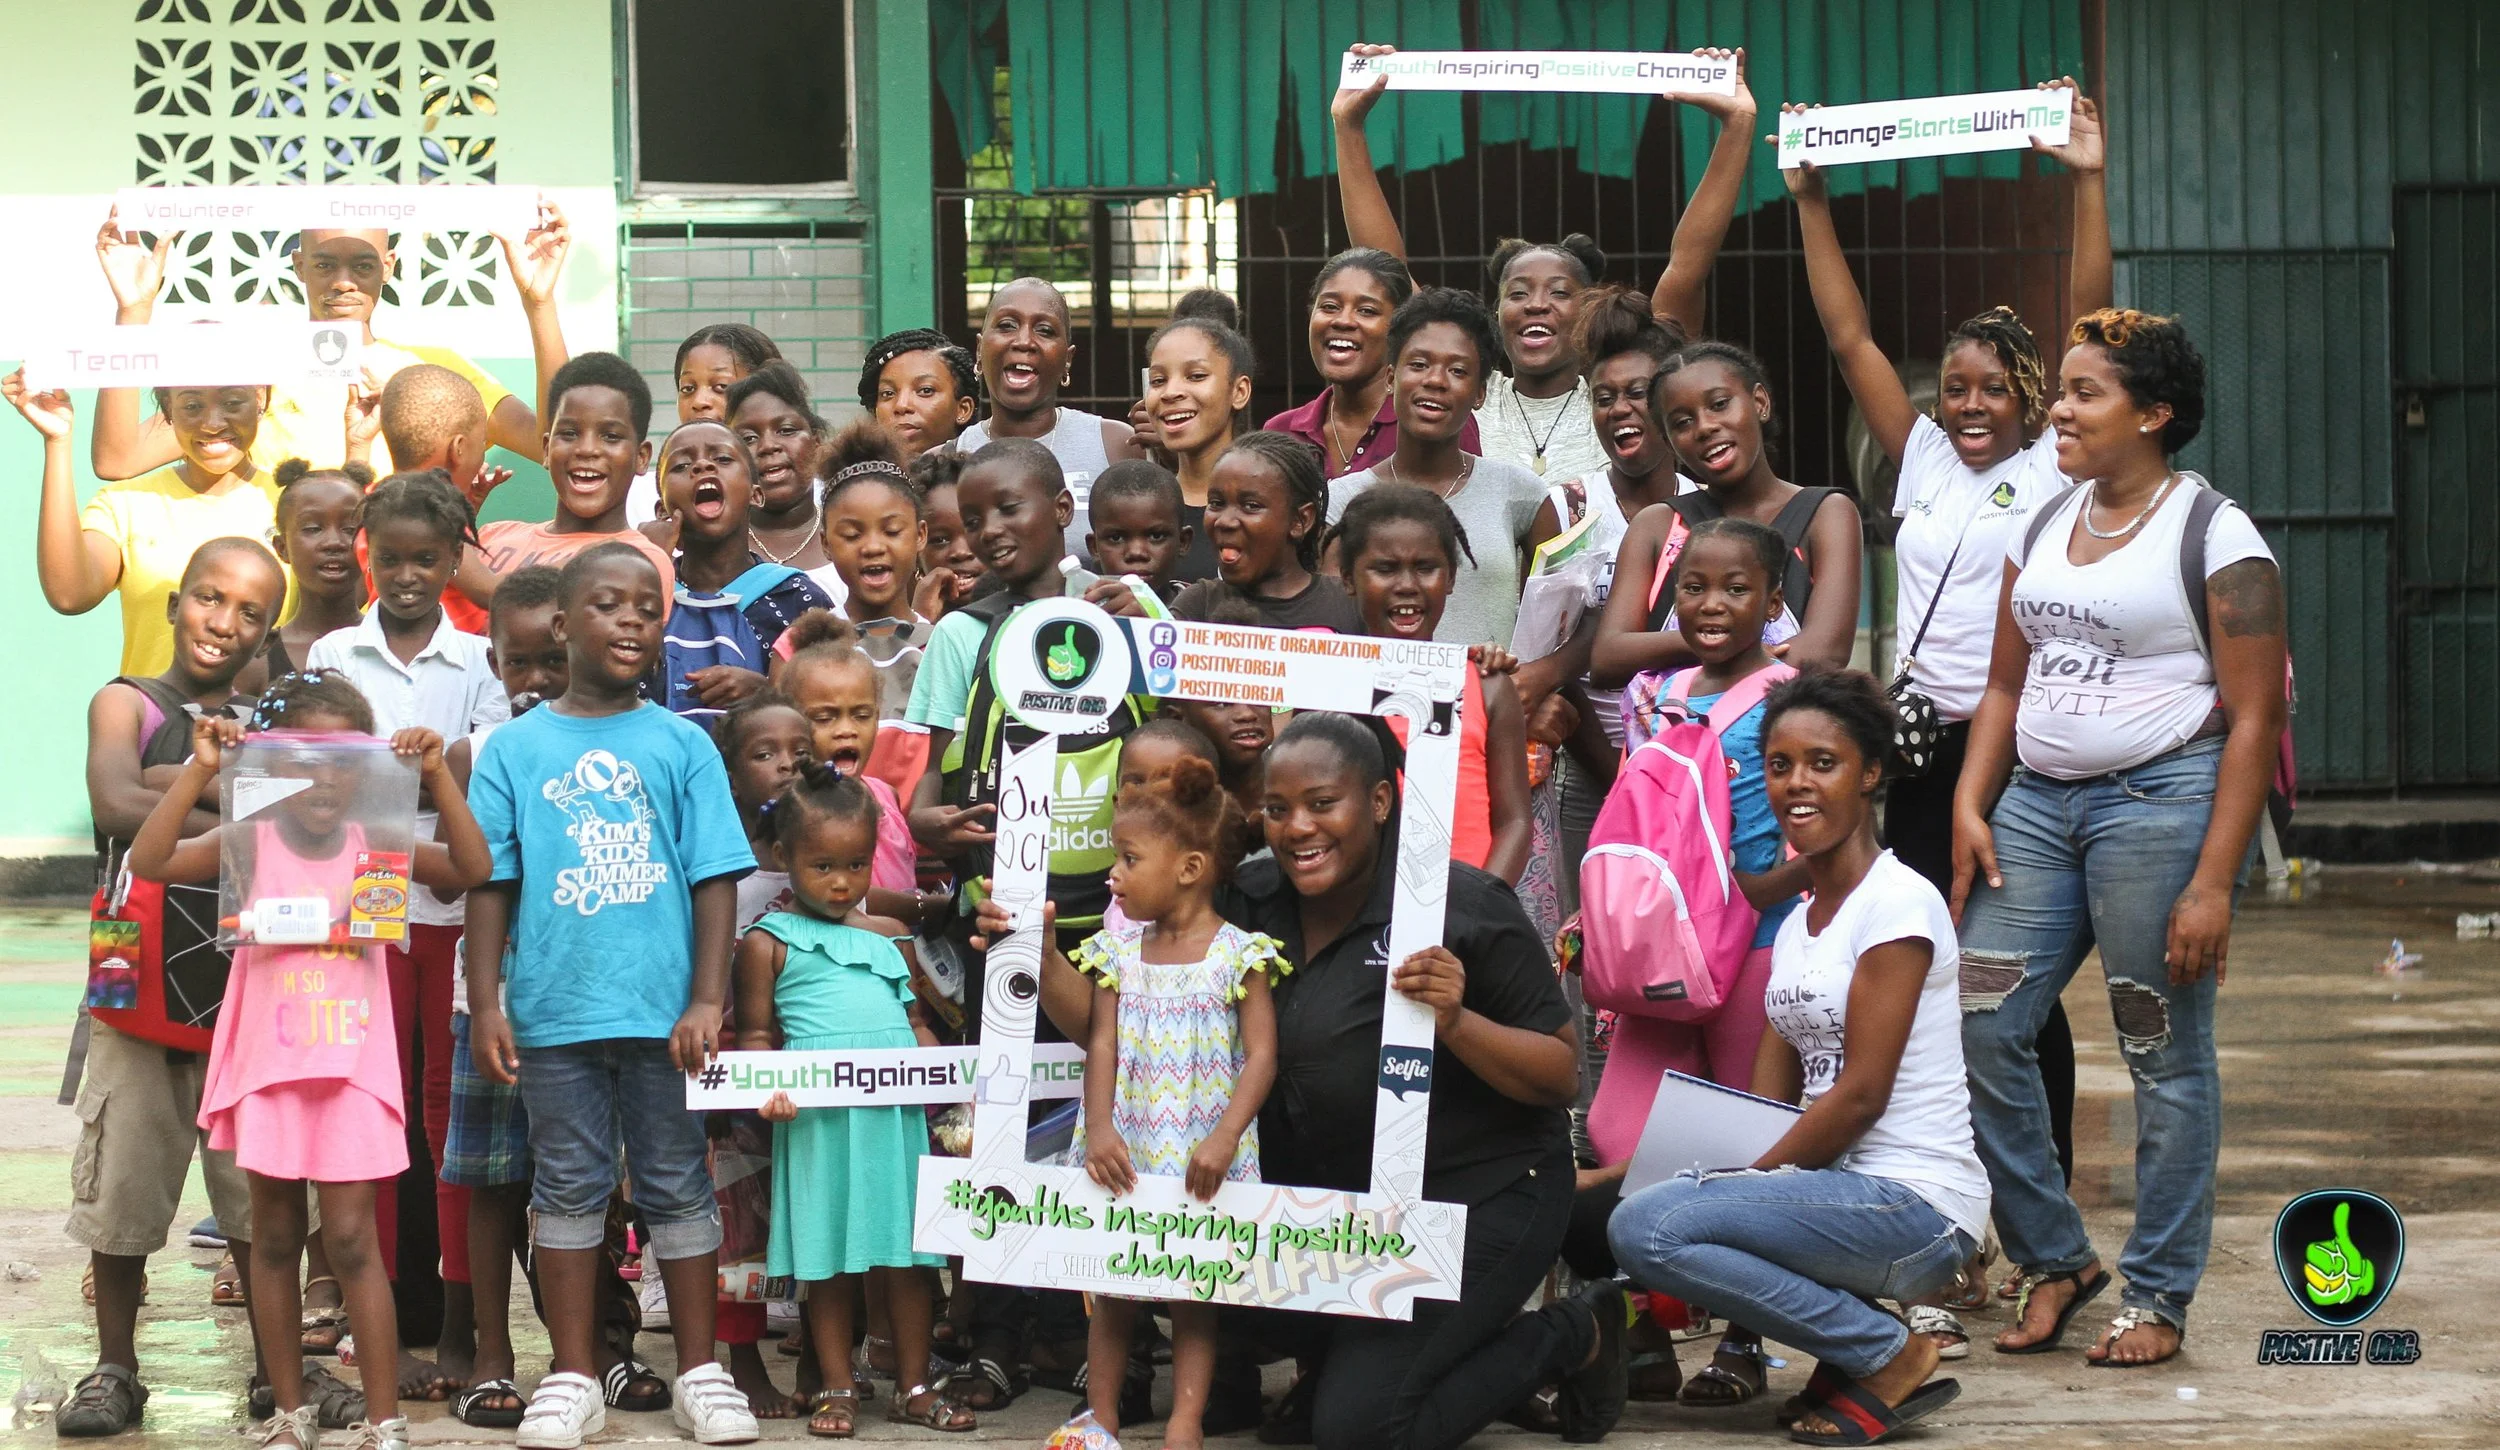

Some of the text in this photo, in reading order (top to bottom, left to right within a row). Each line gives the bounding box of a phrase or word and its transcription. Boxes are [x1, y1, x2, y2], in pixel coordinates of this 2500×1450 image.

[1348, 57, 1728, 83] #YouthInspiringPositiveChange
[1784, 106, 2064, 149] #ChangeStartsWithMe
[143, 201, 417, 220] Volunteer Change
[67, 350, 159, 371] Team
[1183, 627, 1382, 660] THE POSITIVE ORGANIZATION
[1396, 643, 1455, 668] CHEESE
[1181, 653, 1287, 678] POSITIVEORGJA
[1018, 690, 1077, 713] POSITIVE
[1178, 678, 1285, 703] POSITIVEORGJA
[1050, 825, 1115, 851] dida
[580, 842, 650, 866] KIDS
[553, 863, 668, 906] SUMMER
[577, 882, 655, 917] CAMP
[302, 970, 326, 993] SO
[699, 1059, 1085, 1094] #YouthAgainstVnce
[1383, 1056, 1430, 1081] Selfie
[944, 1178, 1416, 1262] #youths inspiring positive
[1106, 1241, 1244, 1300] change
